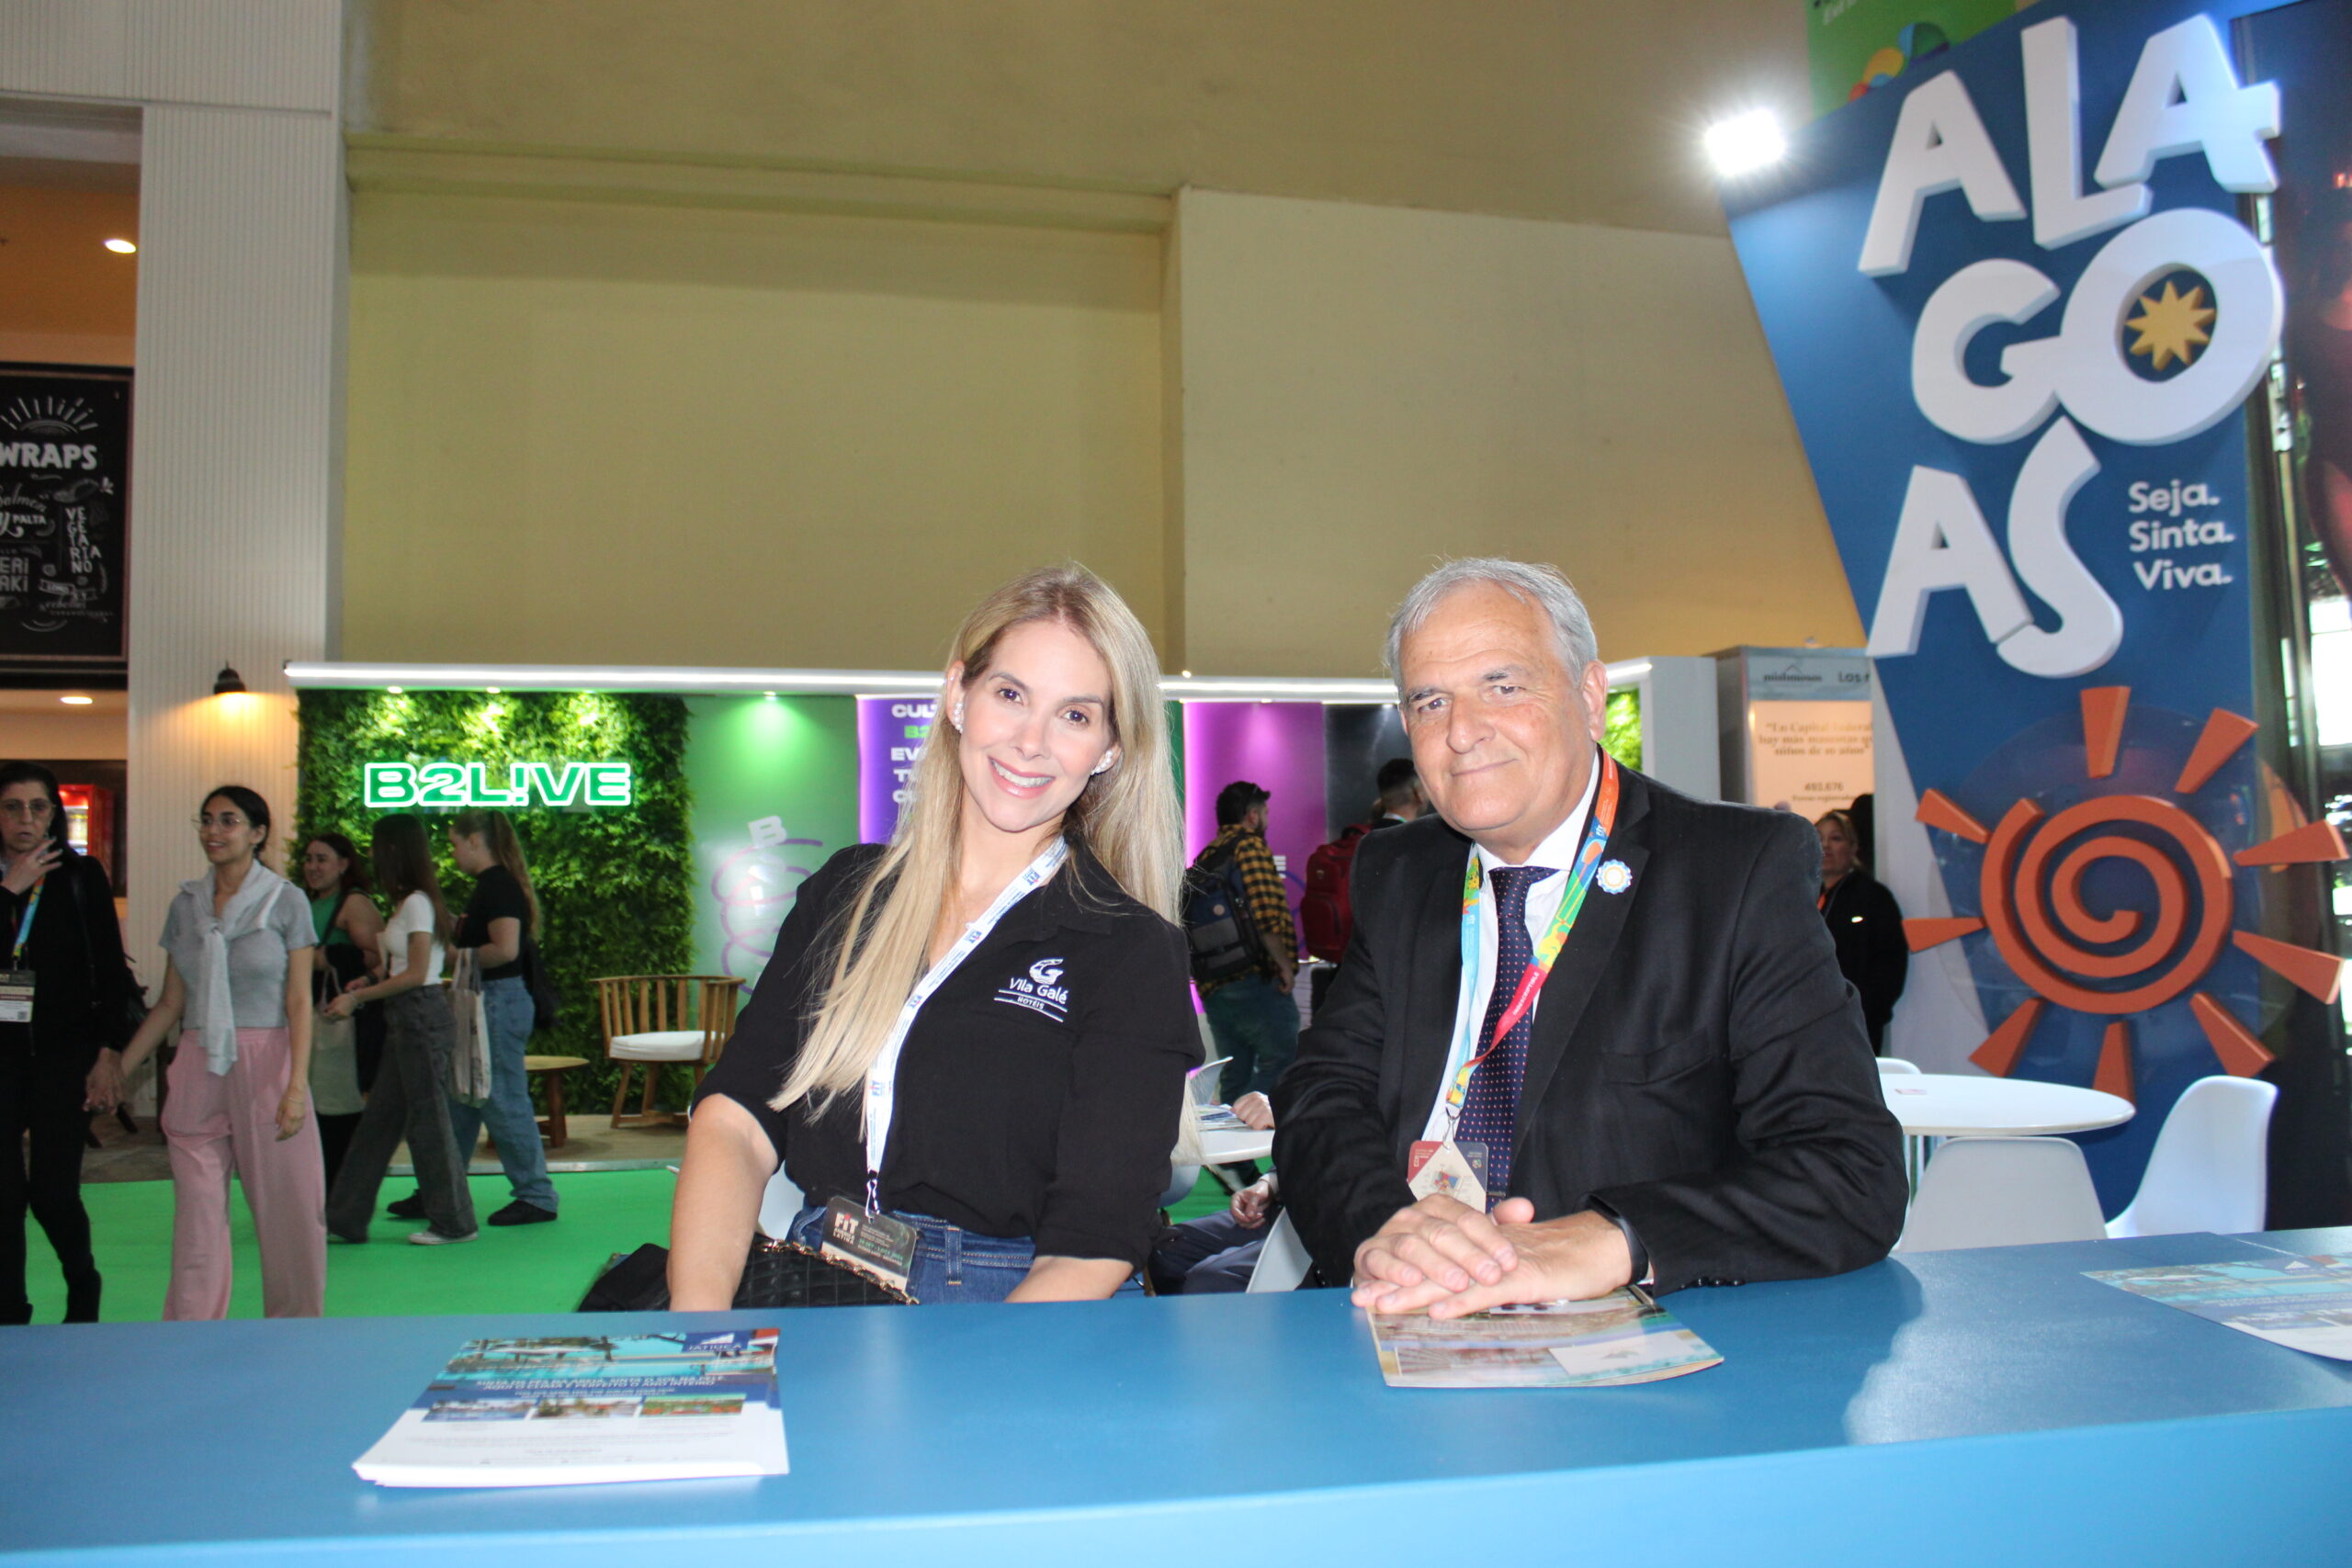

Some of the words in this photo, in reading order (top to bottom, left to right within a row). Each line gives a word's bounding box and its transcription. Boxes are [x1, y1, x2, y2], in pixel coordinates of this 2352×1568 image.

[0, 442, 97, 470] WRAPS
[2128, 479, 2221, 517] Seja.
[13, 514, 47, 525] PALTA
[2129, 518, 2236, 552] Sinta.
[2132, 558, 2233, 591] Viva.
[1009, 976, 1034, 993] Vila
[1036, 985, 1069, 1005] Galé
